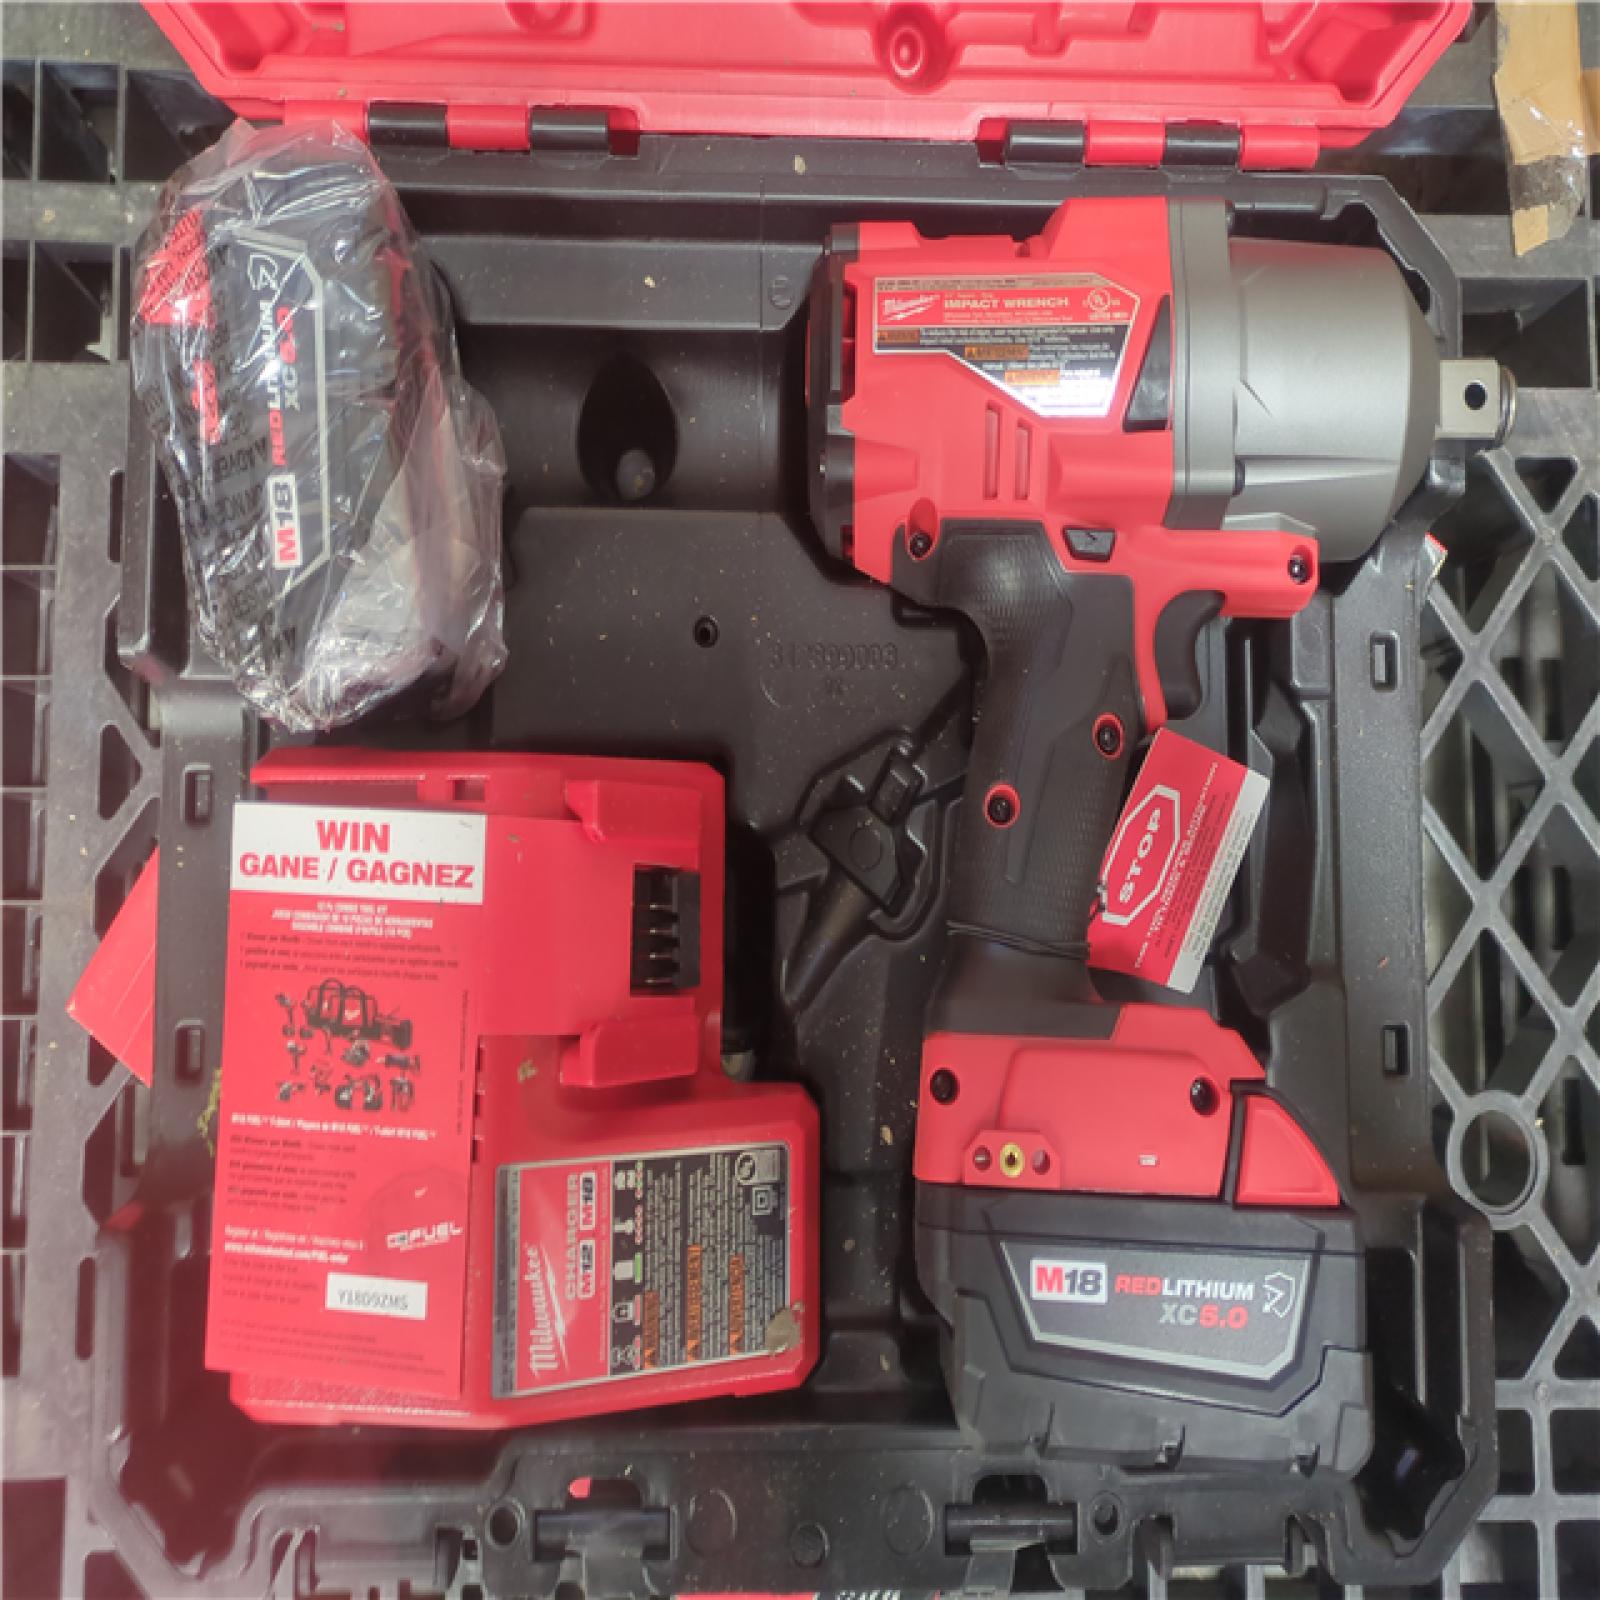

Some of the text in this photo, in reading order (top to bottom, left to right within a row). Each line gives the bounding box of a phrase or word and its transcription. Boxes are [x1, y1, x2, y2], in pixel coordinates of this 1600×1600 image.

[944, 296, 1069, 309] IMPACT WRENCH
[274, 481, 299, 562] M18
[315, 820, 391, 854] WIN
[1120, 808, 1162, 903] STOP
[239, 852, 320, 880] GANE
[346, 858, 476, 888] GAGNEZ
[566, 1174, 579, 1300] CHARGER
[524, 1243, 560, 1377] Milwaukee
[1035, 1264, 1254, 1301] M18 REDLITHIUM
